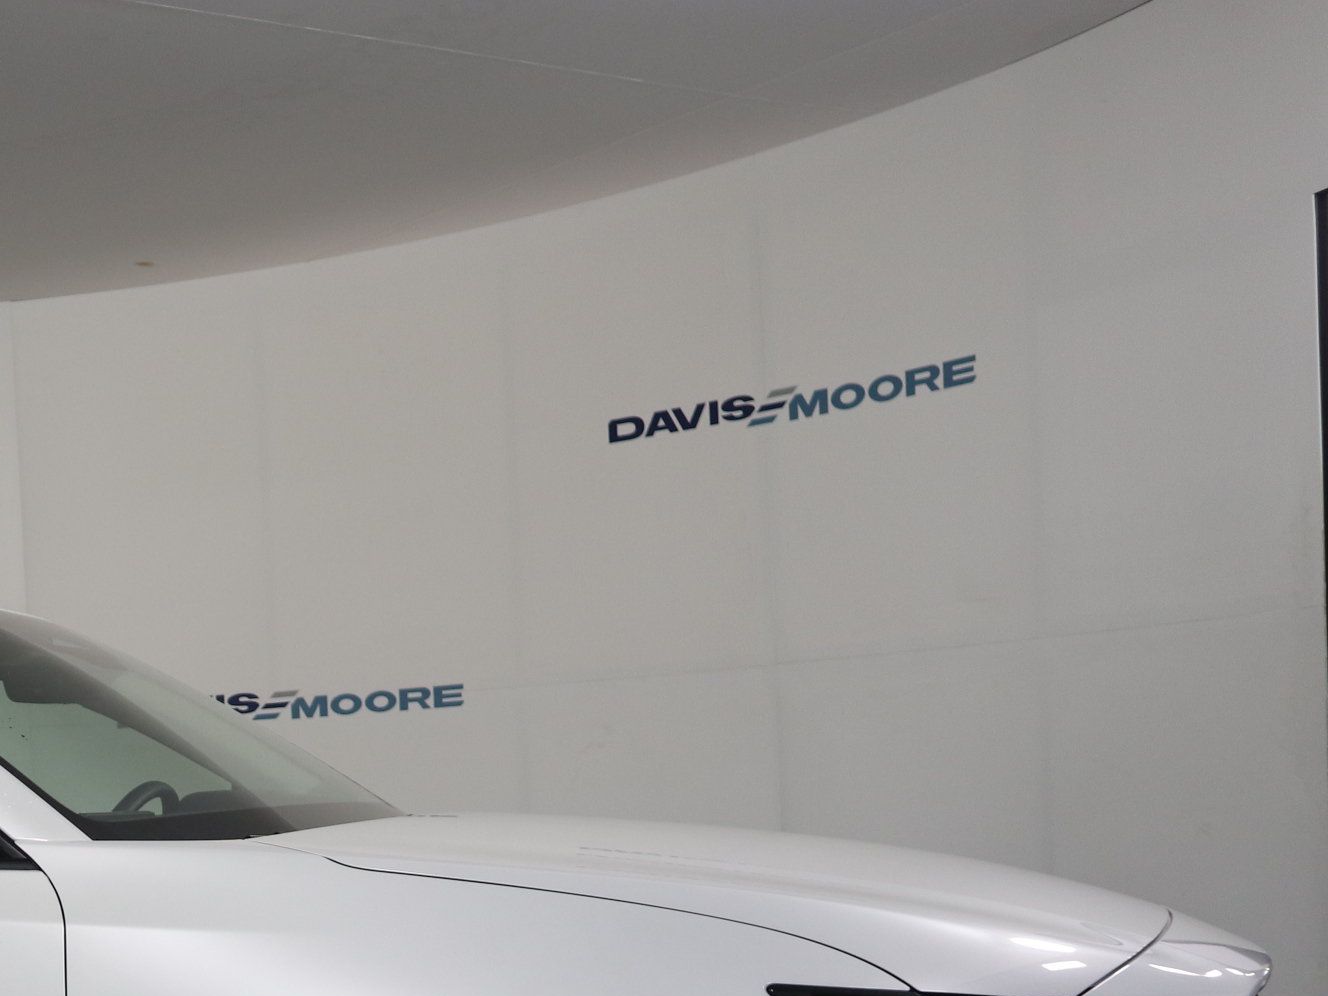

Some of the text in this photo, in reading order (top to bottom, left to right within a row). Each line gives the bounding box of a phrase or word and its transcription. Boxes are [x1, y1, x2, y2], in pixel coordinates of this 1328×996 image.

[608, 354, 977, 443] DAVIS MOORE
[290, 683, 464, 719] MOORE
